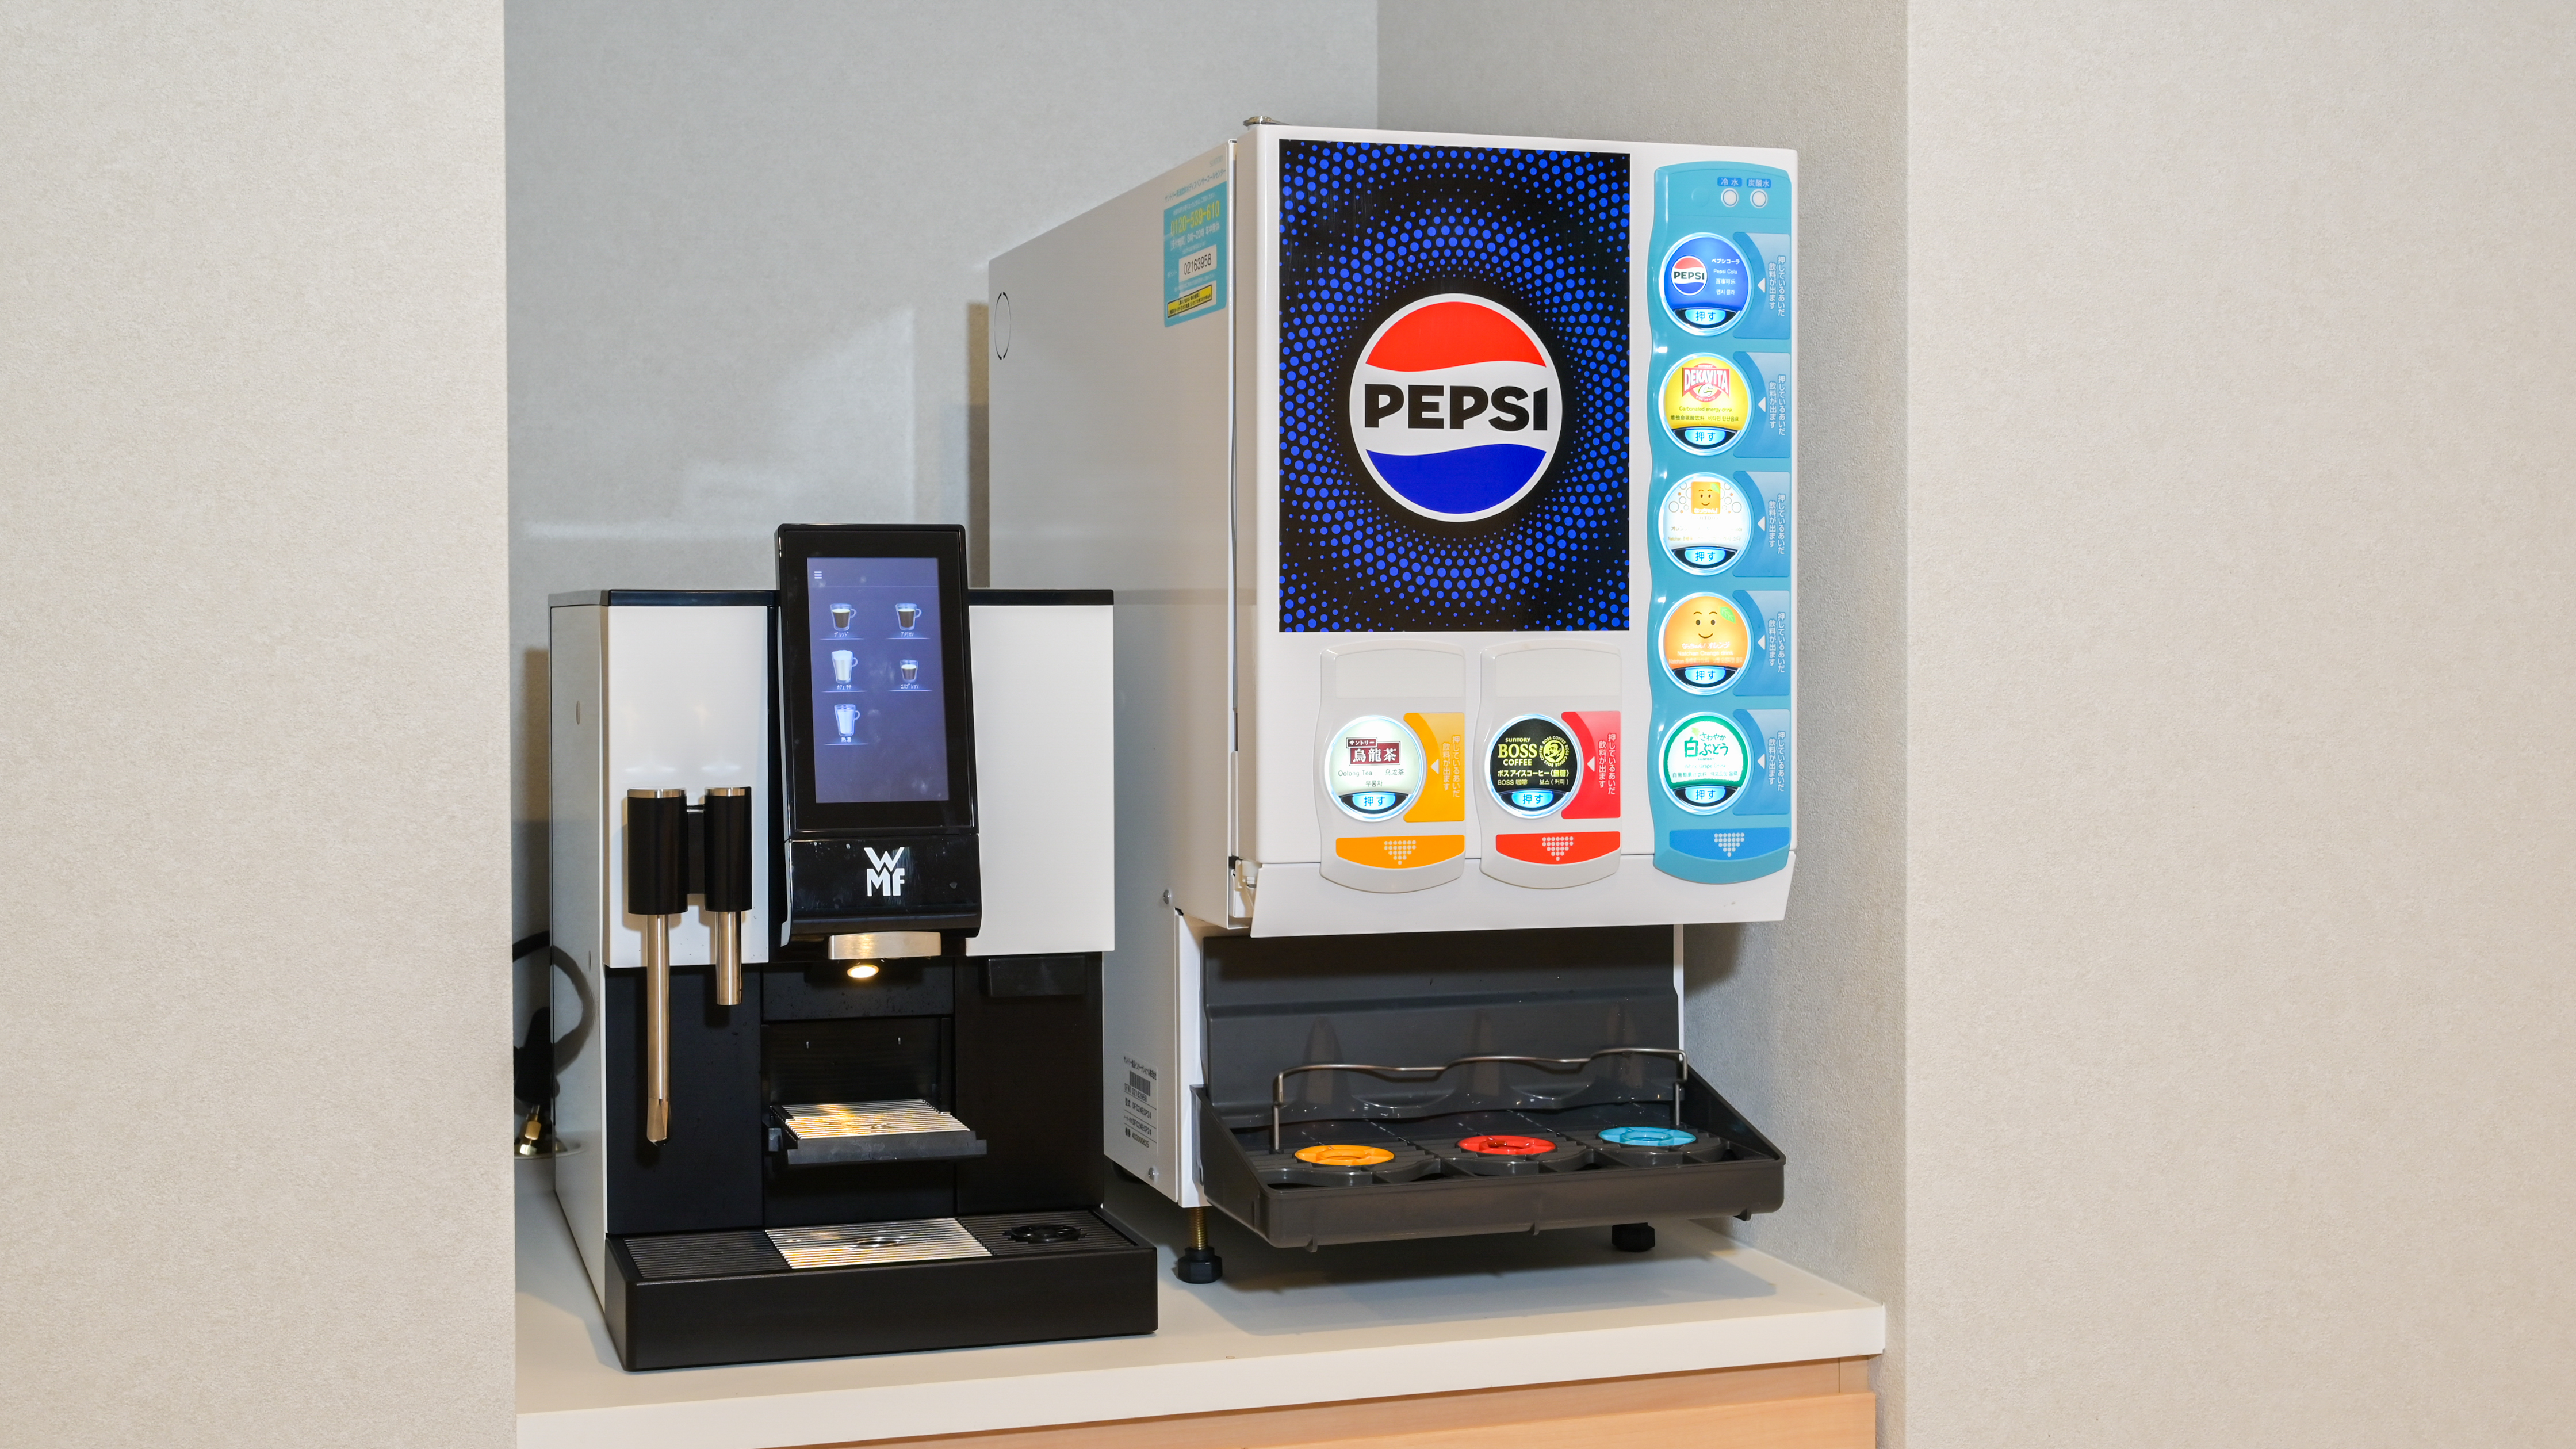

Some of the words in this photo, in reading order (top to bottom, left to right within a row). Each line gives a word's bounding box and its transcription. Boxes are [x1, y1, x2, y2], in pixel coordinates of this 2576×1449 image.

[1721, 178, 1739, 186] 冷水
[1748, 179, 1770, 188] 炭酸水
[1184, 253, 1212, 275] 02163958
[1674, 272, 1705, 280] PEPSI
[1769, 262, 1777, 309] 飲料が出ます
[1695, 311, 1716, 322] 押す
[1685, 369, 1729, 393] DEKAVITA
[1698, 383, 1714, 397] C
[1364, 383, 1548, 432] PEPSI
[1695, 432, 1716, 442] 押す
[1695, 552, 1716, 561] 押す
[1695, 671, 1716, 680] 押す
[1542, 736, 1552, 745] BOSS
[1552, 736, 1567, 744] COFFEE
[1700, 732, 1726, 741] さわやか
[1498, 743, 1537, 758] BOSS
[1684, 736, 1728, 758] 白ぶどう
[1353, 748, 1397, 762] 烏龍茶
[1768, 738, 1776, 785] 飲料が出ます
[1442, 743, 1450, 790] 飲料が出ます
[1452, 736, 1460, 797] 押しているあいだ
[1608, 733, 1616, 795] 押しているあいだ
[1364, 796, 1385, 806] 押す
[1523, 794, 1543, 804] 押す
[1695, 790, 1716, 800] 押す
[864, 847, 905, 897] WMF
